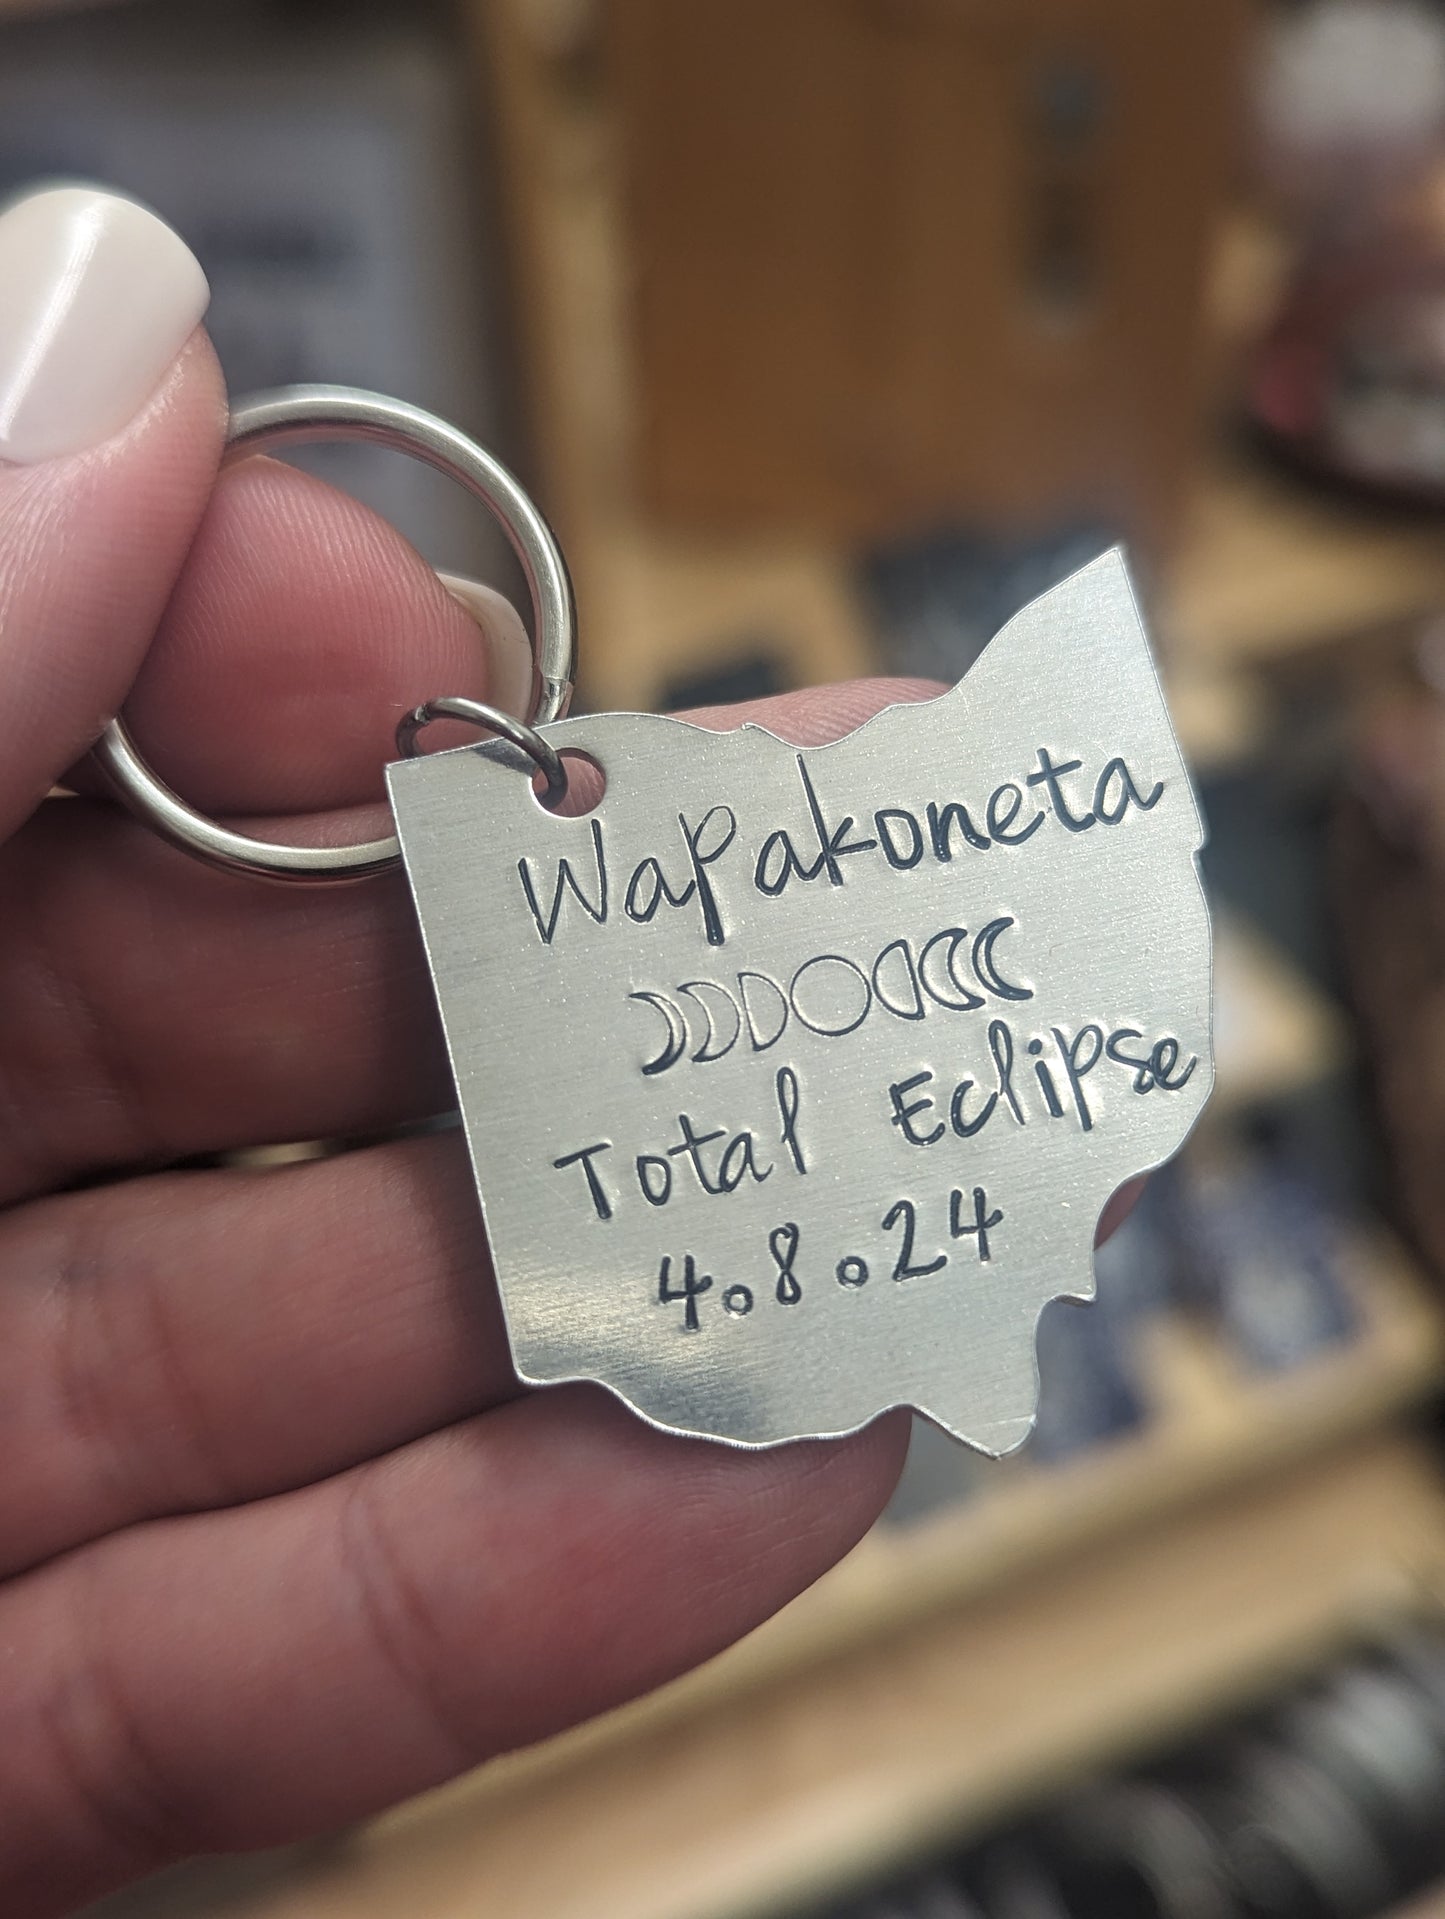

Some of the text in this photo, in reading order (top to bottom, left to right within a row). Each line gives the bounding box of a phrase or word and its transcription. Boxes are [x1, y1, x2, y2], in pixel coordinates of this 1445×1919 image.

[518, 747, 1164, 946] Wapakoneta
[553, 1018, 1198, 1220] Total Eclipse
[658, 1186, 1004, 1332] 4.8.24
